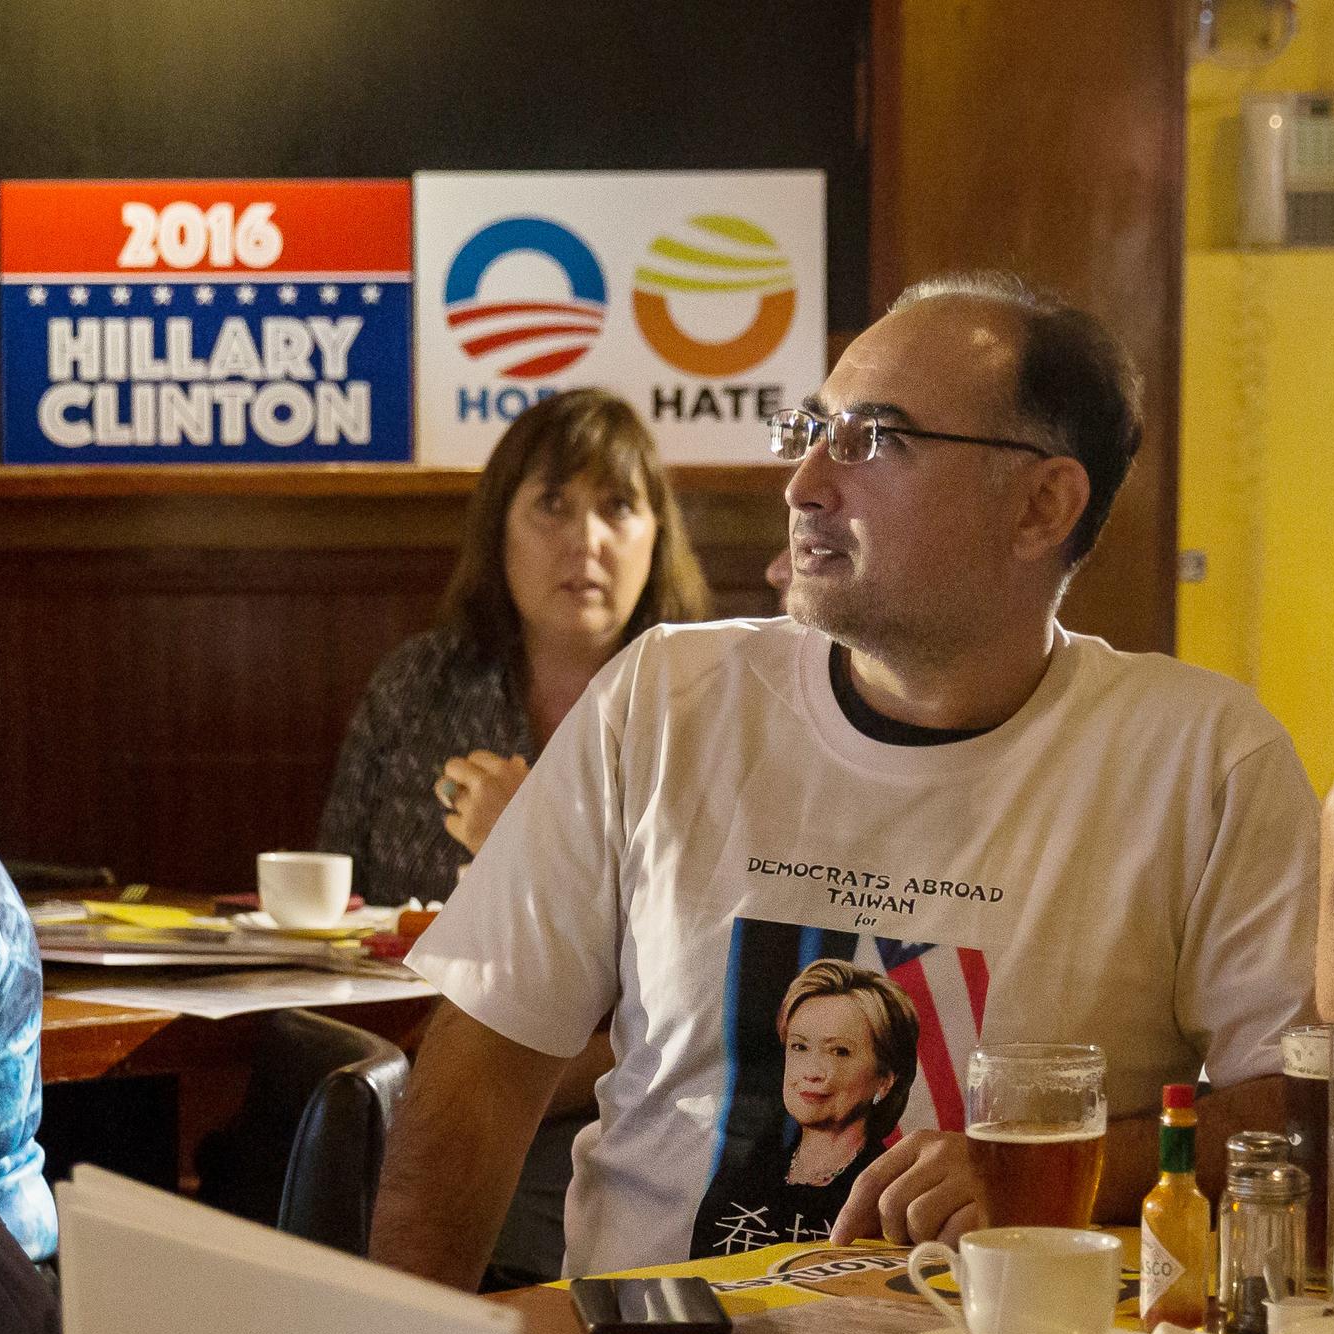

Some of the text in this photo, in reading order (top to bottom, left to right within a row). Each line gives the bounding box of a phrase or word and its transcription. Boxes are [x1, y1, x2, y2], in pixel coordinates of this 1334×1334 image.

[117, 201, 284, 270] 2016
[47, 315, 364, 382] HILLARY
[37, 380, 371, 448] CLINTON
[653, 384, 783, 422] HATE
[747, 856, 1005, 903] DEMOCRATS ABROAD
[827, 887, 916, 915] TAIWAN
[854, 912, 878, 928] for
